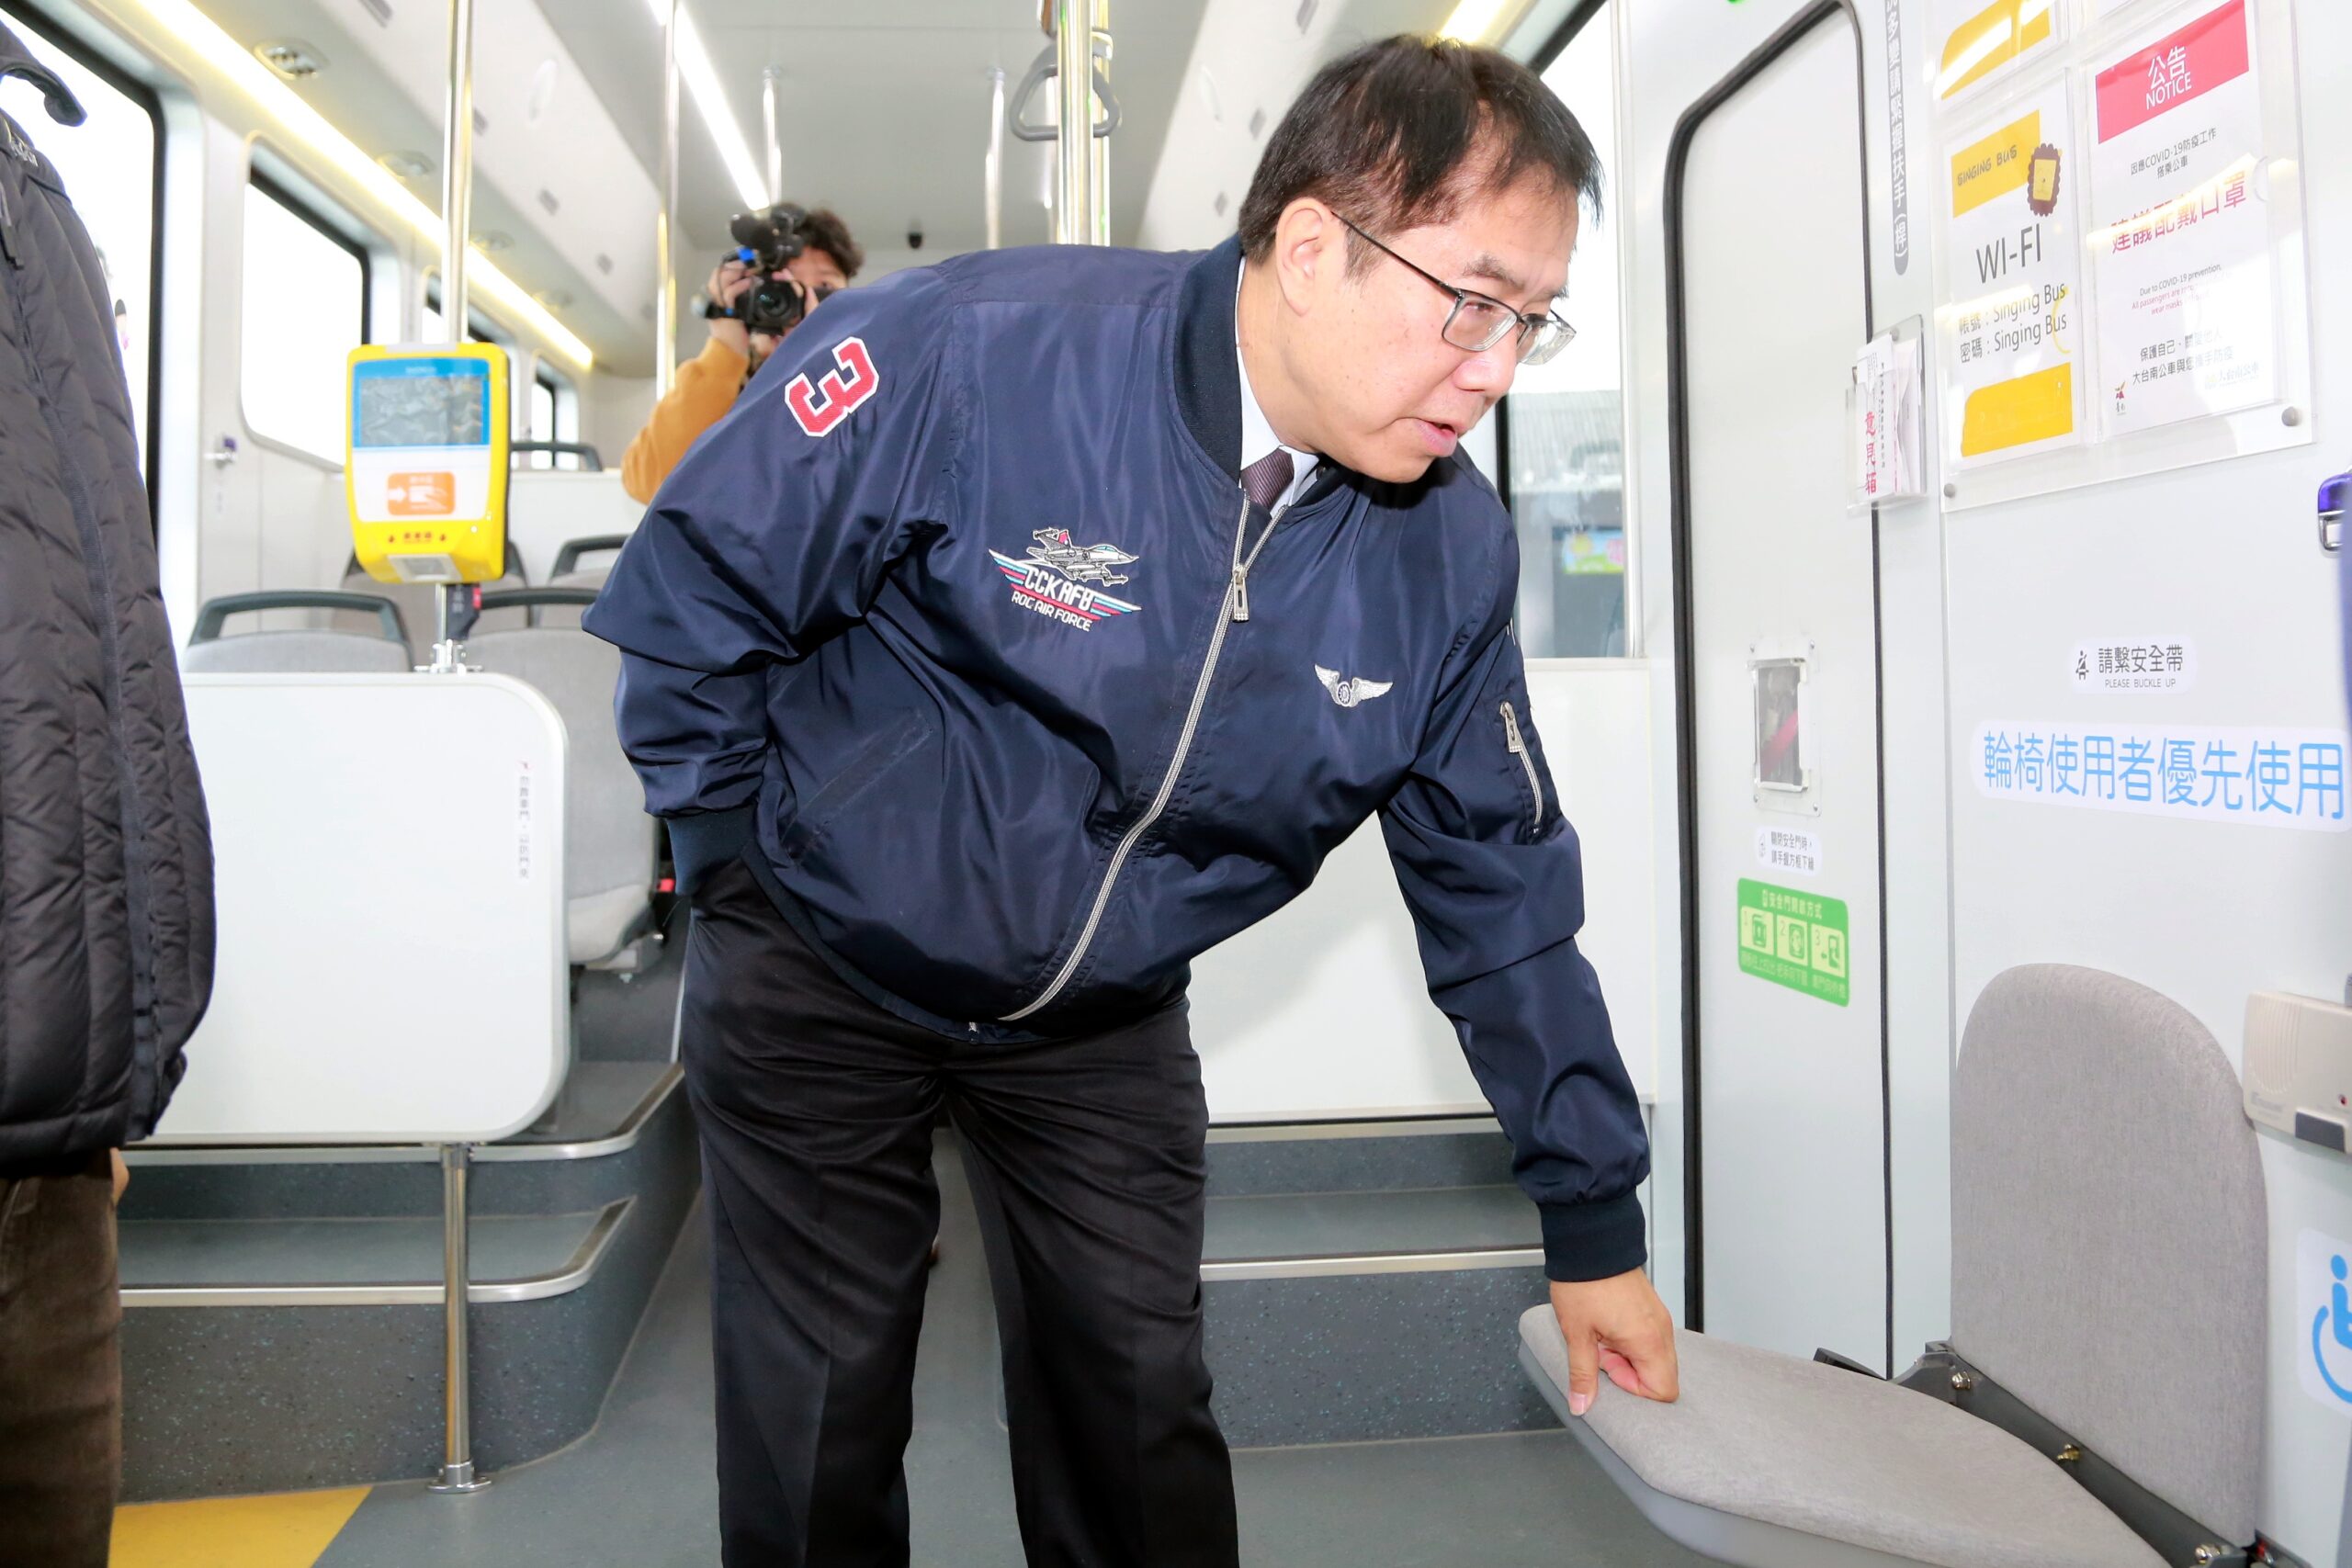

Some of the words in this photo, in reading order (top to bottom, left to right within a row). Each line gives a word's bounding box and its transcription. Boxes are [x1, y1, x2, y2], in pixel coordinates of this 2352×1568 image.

[2148, 45, 2187, 90] 公告
[2145, 72, 2192, 110] NOTICE
[2156, 155, 2188, 178] 搭乘公車
[1976, 223, 2041, 284] WI-FI
[2158, 274, 2188, 290] COVID-19
[1993, 292, 2041, 323] Singing
[2043, 283, 2066, 305] Bus
[1995, 322, 2042, 353] Singing
[2045, 314, 2067, 335] Bus
[785, 336, 880, 437] 3
[1011, 591, 1036, 609] ROC
[1034, 600, 1055, 617] AIR
[1054, 608, 1093, 632] FORCE
[2098, 644, 2183, 673] 請繫安全帶
[2105, 679, 2131, 688] PLEASE
[2134, 678, 2162, 688] BUCKLE
[2165, 678, 2177, 688] UP
[1984, 730, 2345, 819] 輪椅使用者優先使用
